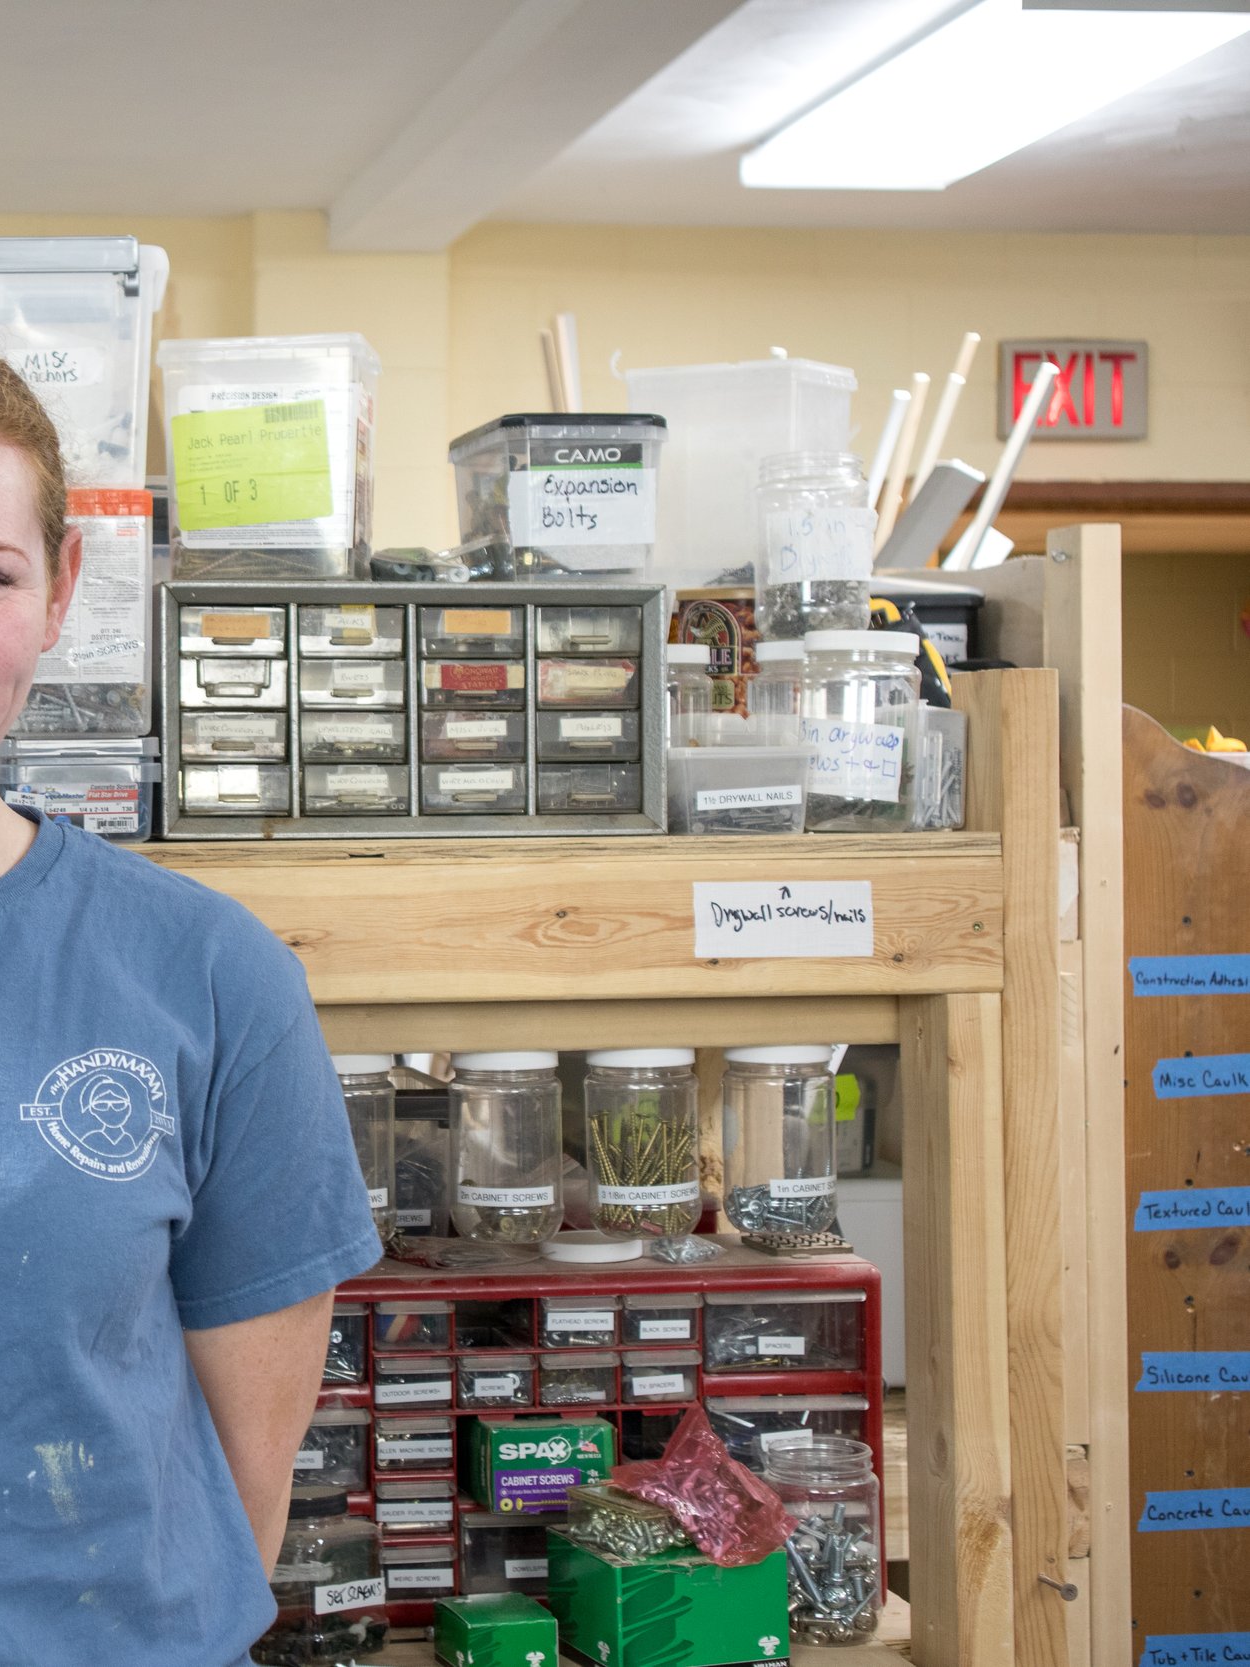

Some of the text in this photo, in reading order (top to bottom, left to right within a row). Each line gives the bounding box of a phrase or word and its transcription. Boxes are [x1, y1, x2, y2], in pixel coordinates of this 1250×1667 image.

[1012, 352, 1137, 428] EXIT
[187, 436, 214, 450] Jack
[554, 447, 622, 463] CAMO
[224, 480, 240, 503] OF
[249, 478, 258, 501] 3
[543, 474, 638, 502] Expansion
[542, 504, 598, 530] Bolts
[96, 639, 139, 657] SCREWS
[719, 792, 763, 804] DRYWALL
[766, 791, 793, 801] NAILS
[711, 902, 772, 932] Drywall
[1136, 971, 1206, 986] Construction
[1160, 1071, 1249, 1088] Misc Caulk
[30, 1107, 53, 1116] EST.
[47, 1122, 160, 1173] Home Repairs and Renovations
[628, 1191, 667, 1200] CABINET
[670, 1187, 699, 1199] SCREWS
[777, 1185, 789, 1193] 1in
[792, 1183, 825, 1193] CABINET
[472, 1193, 509, 1202] CABINET
[512, 1192, 549, 1201] SCREWS
[1144, 1200, 1211, 1220] Textured
[1147, 1366, 1210, 1385] Silicone
[649, 1381, 676, 1389] SPACERS
[382, 1390, 411, 1398] OUTDOOR
[499, 1440, 569, 1461] SPAX
[501, 1475, 575, 1487] CABINET SCREWS
[1147, 1501, 1213, 1521] Concrete
[1150, 1649, 1176, 1666] Tub
[1191, 1647, 1217, 1663] Tile
